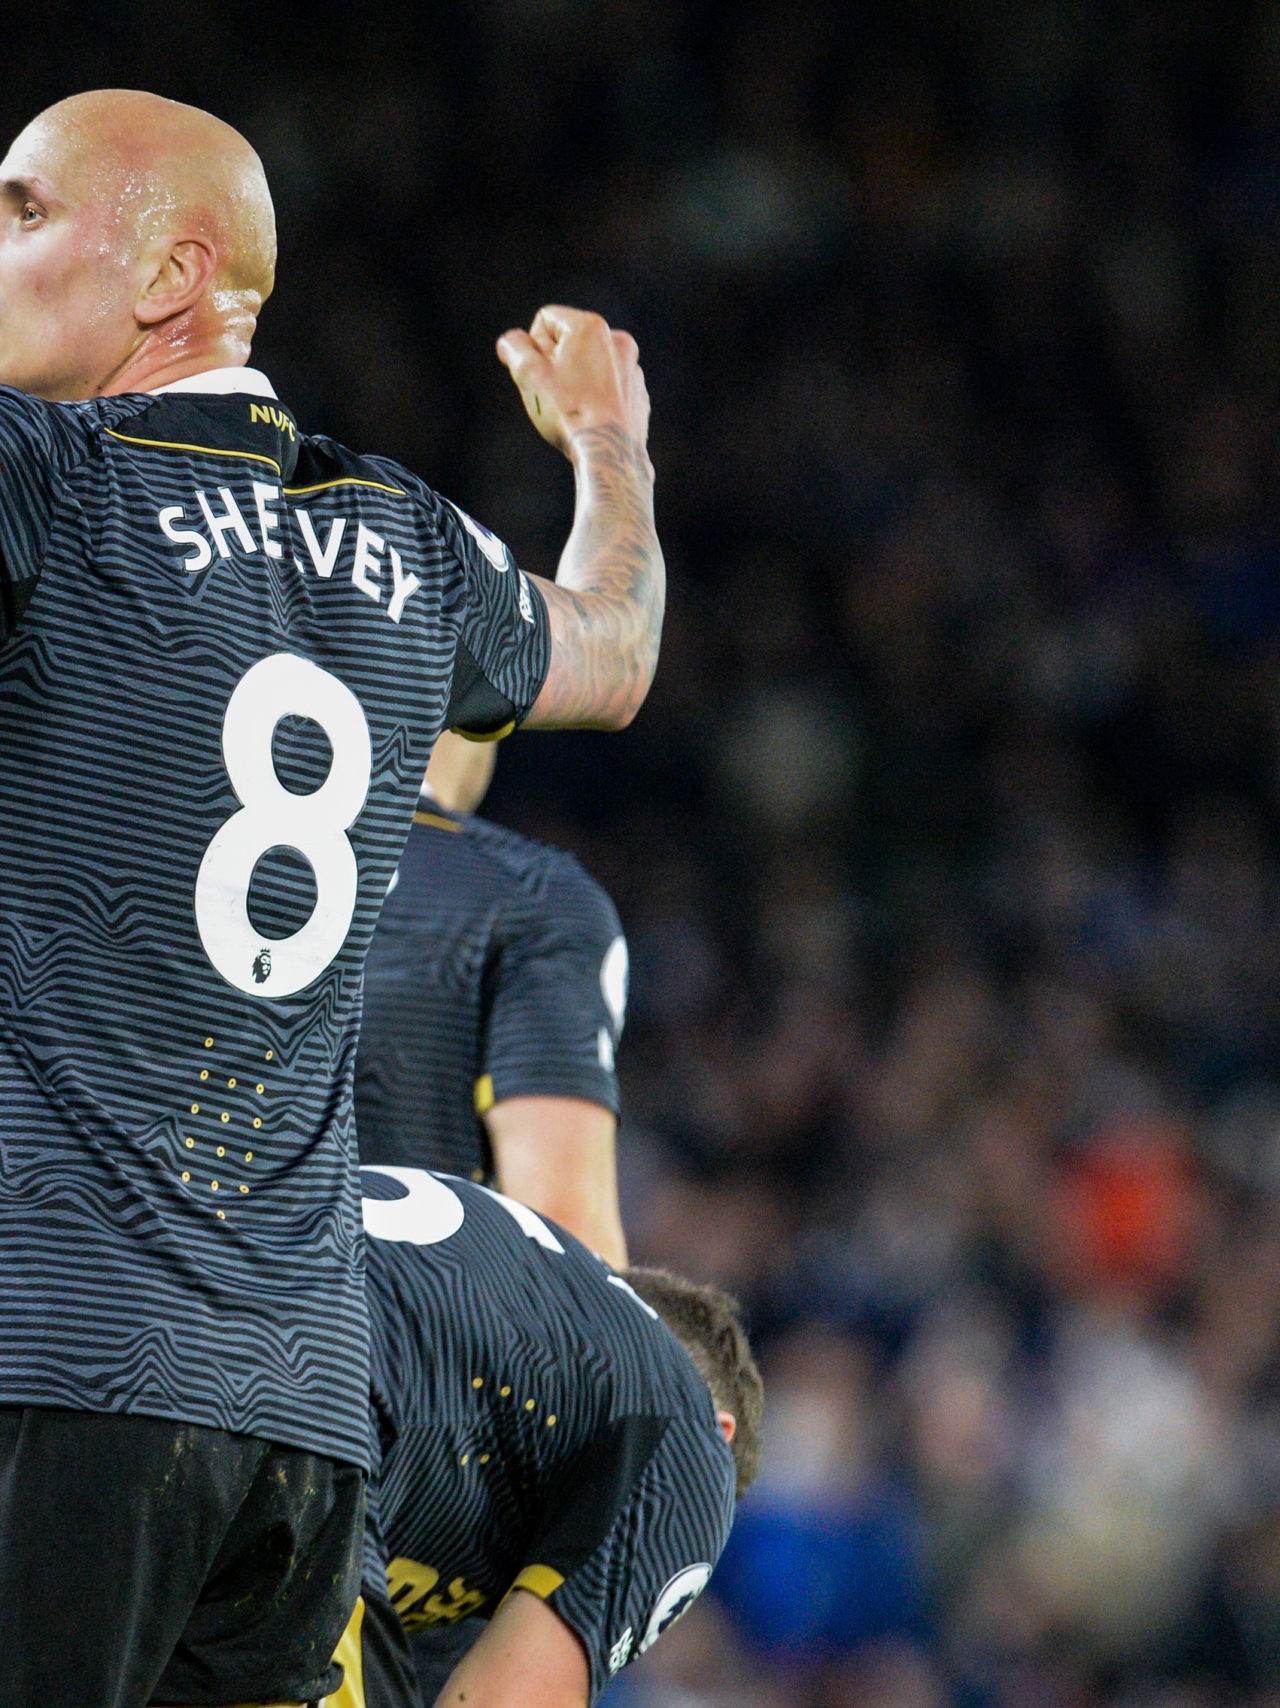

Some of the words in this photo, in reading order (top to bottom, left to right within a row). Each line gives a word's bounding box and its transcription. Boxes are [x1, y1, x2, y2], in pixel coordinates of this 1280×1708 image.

[250, 403, 296, 442] NUFC
[158, 481, 422, 624] SHEVEY
[194, 653, 372, 998] 8
